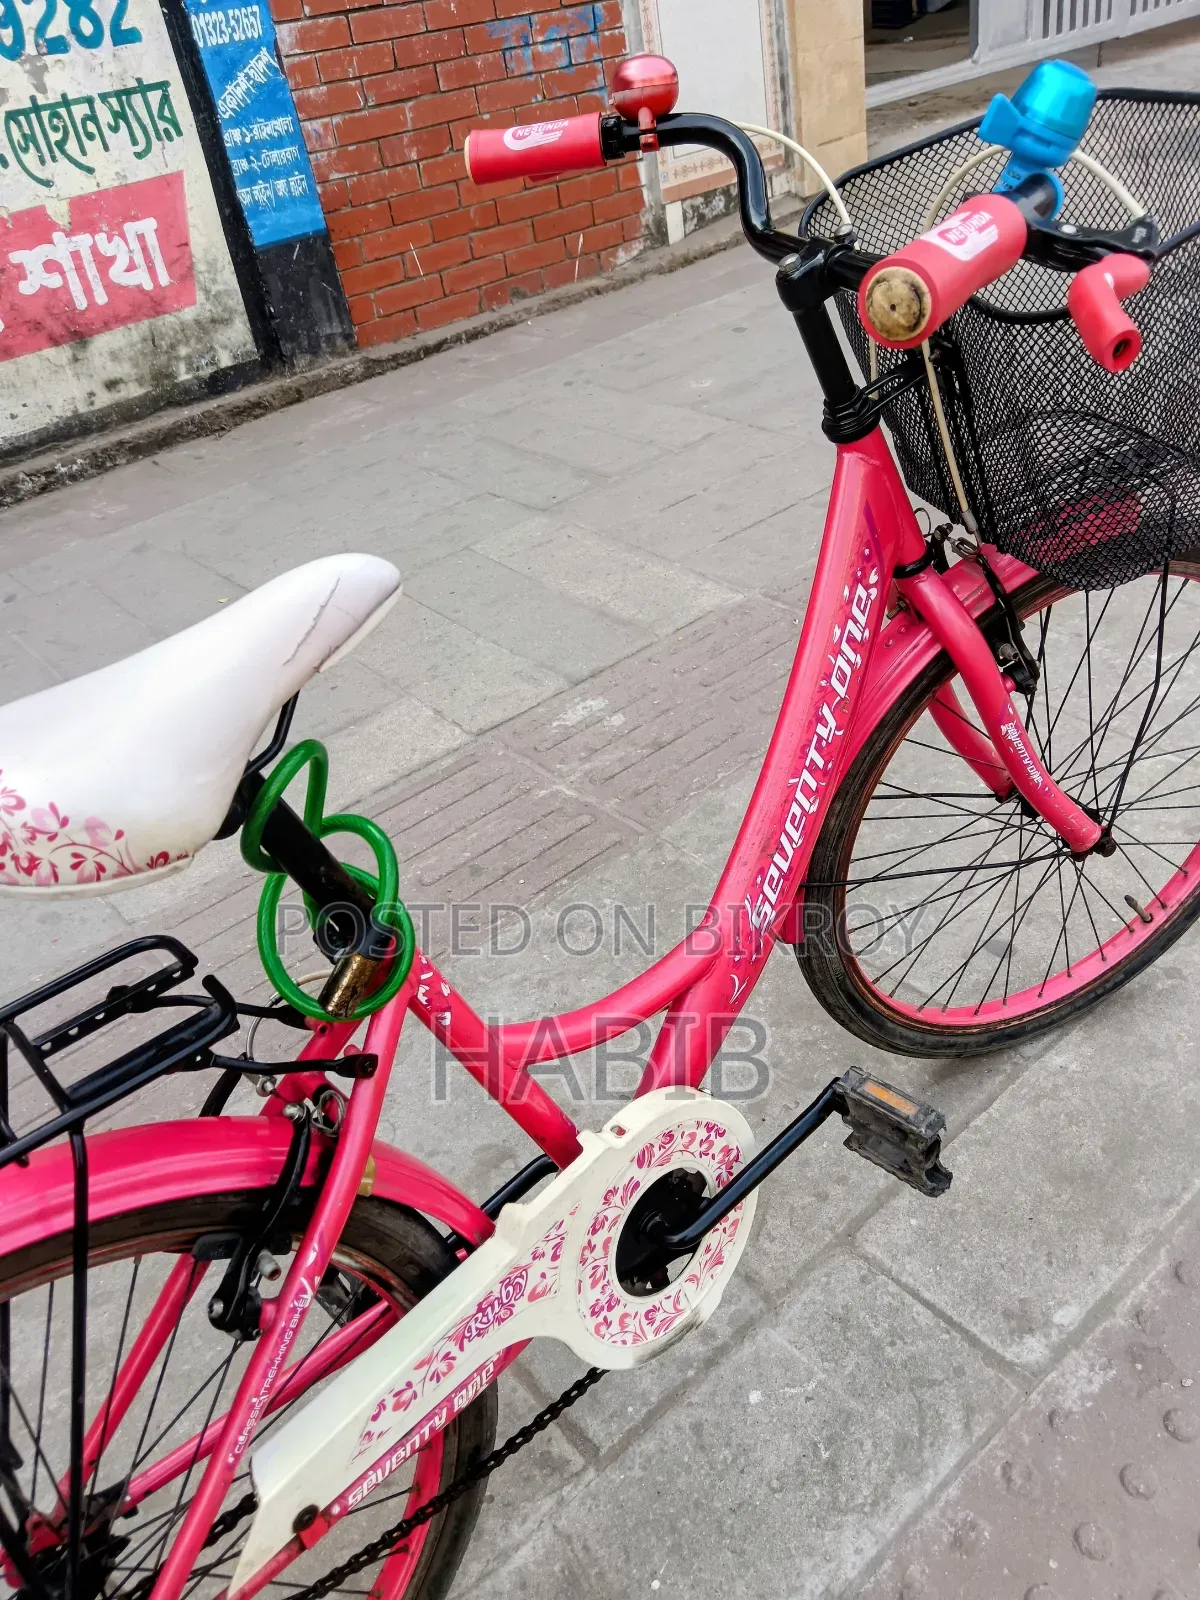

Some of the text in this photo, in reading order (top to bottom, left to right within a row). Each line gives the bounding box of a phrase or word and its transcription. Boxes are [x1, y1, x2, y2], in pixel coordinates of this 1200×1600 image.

[97, 77, 184, 160] স্যার
[9, 216, 171, 311] শাখা
[464, 1268, 529, 1342] Ruby
